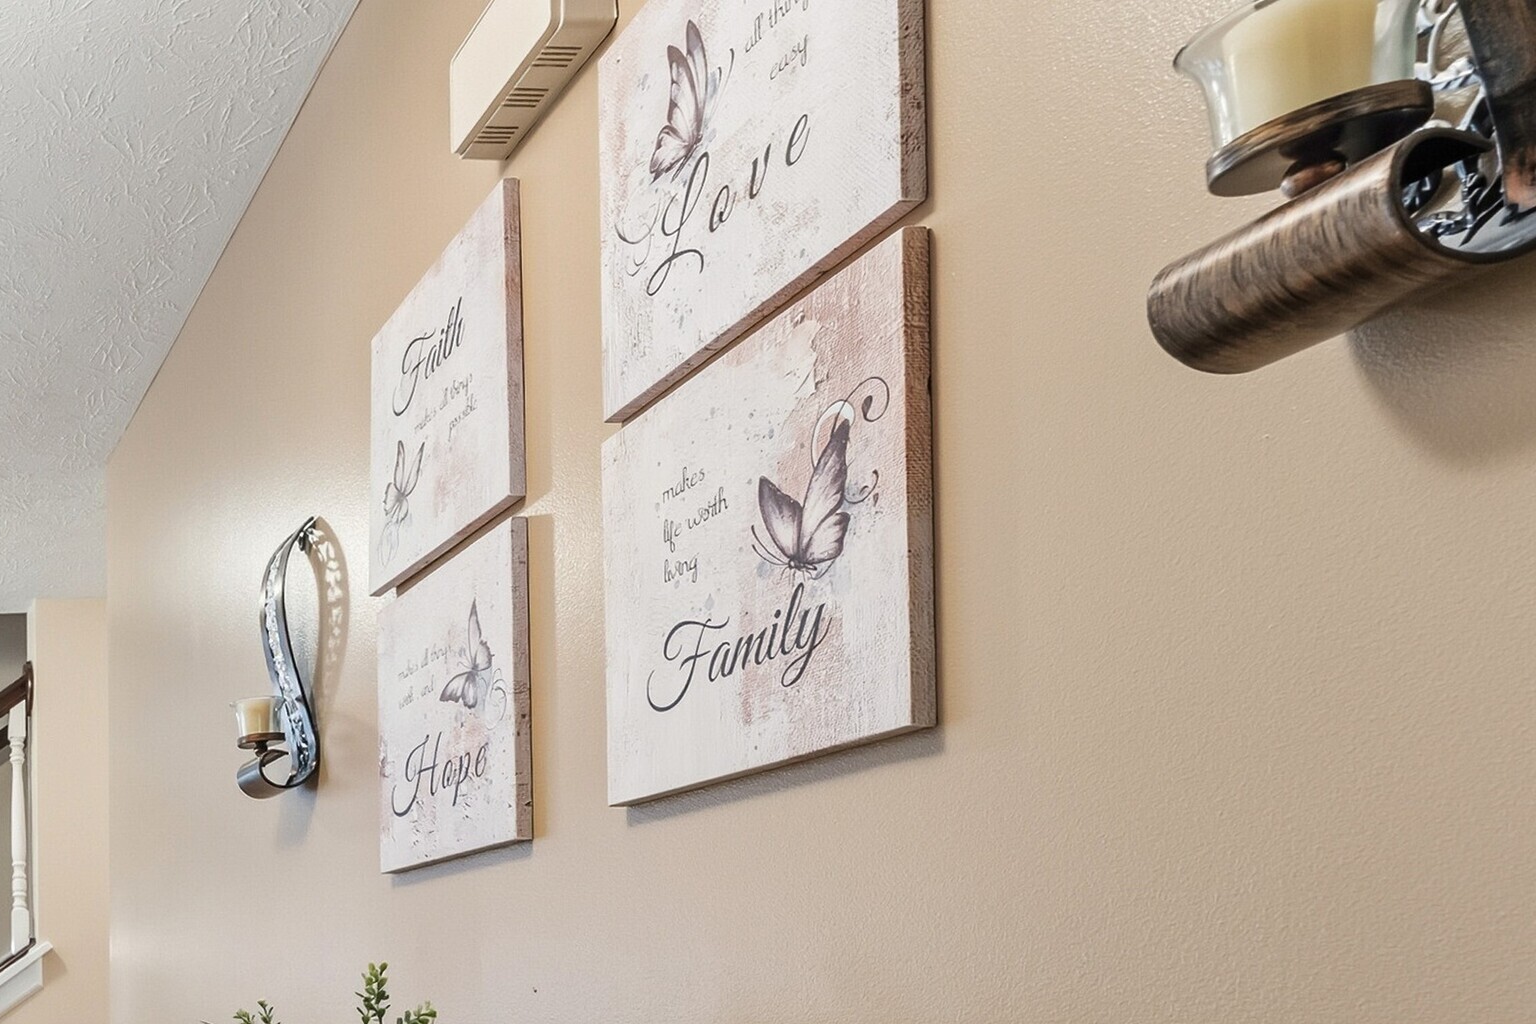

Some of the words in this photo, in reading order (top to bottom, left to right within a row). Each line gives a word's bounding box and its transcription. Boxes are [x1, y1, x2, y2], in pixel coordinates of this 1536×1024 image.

[769, 33, 808, 80] easy
[646, 113, 811, 297] Love
[392, 296, 465, 416] Faith
[662, 465, 705, 504] makes
[663, 519, 682, 553] life
[687, 486, 728, 530] worth
[664, 552, 699, 583] living
[646, 582, 832, 712] Family
[391, 731, 489, 817] Hope
